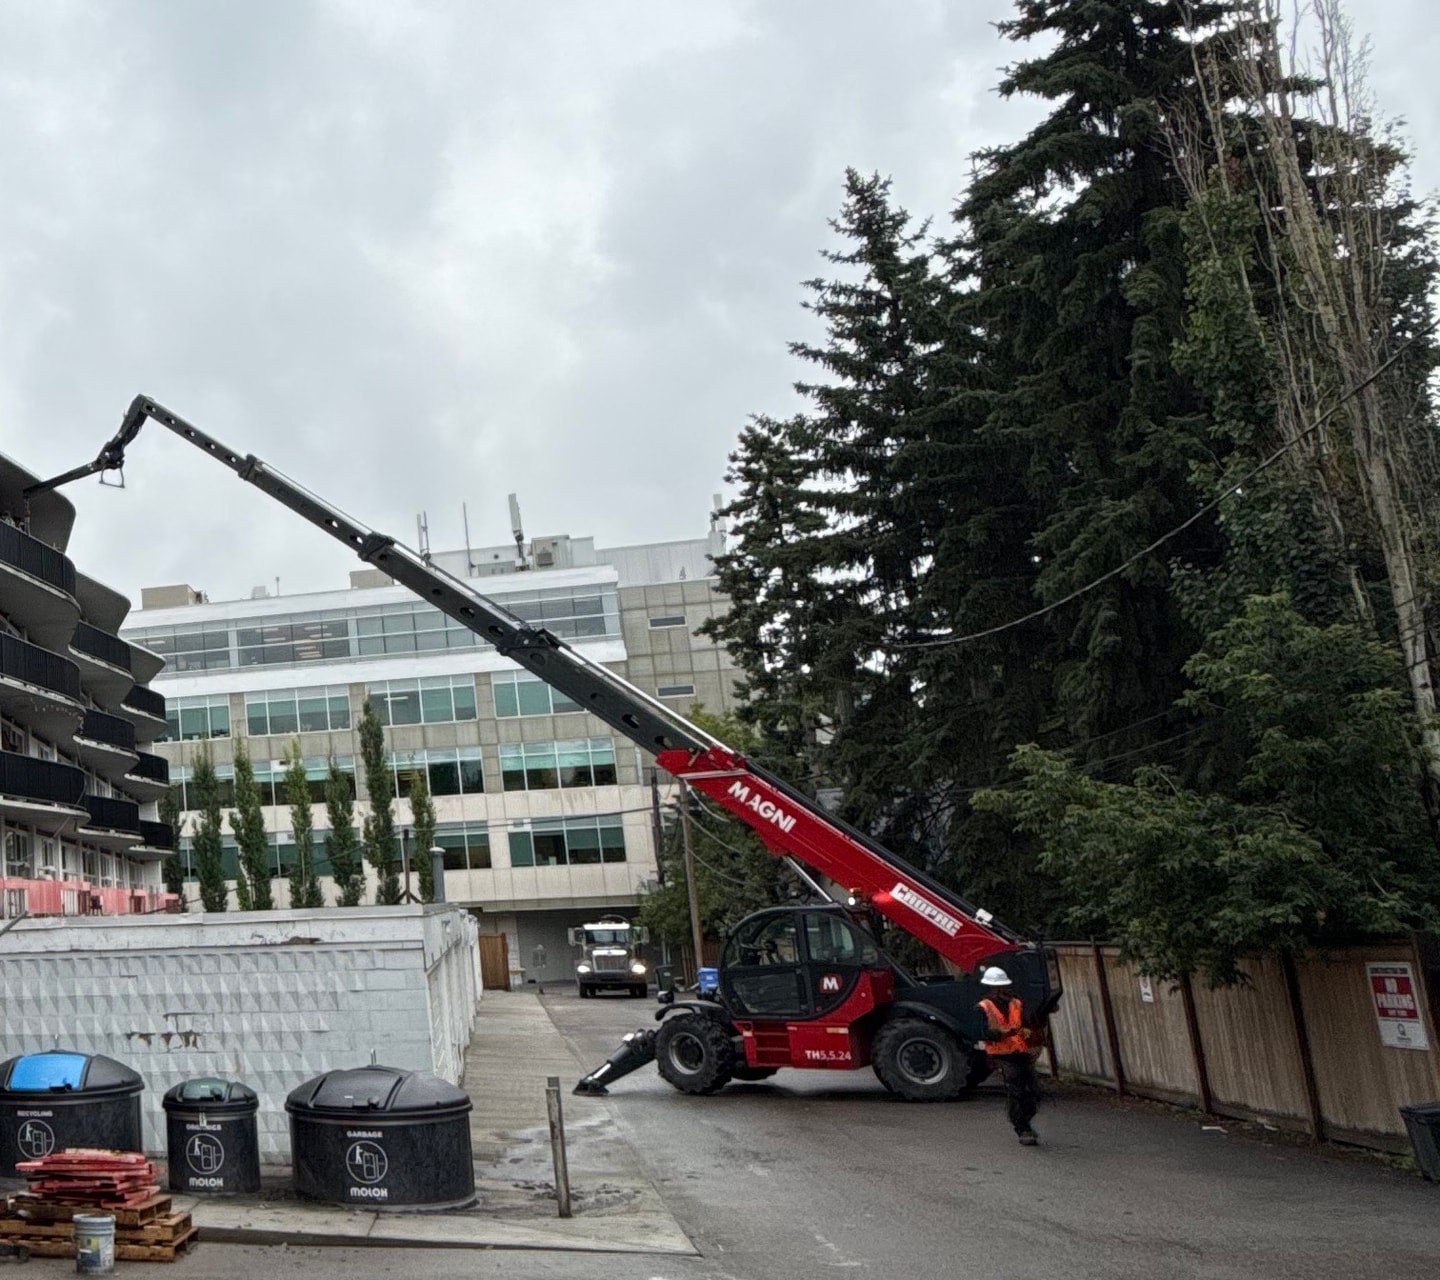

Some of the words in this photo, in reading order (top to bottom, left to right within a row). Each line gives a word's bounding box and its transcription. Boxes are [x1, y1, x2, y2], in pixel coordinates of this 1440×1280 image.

[727, 780, 798, 834] MAGNI
[823, 976, 839, 990] M
[346, 1130, 383, 1138] GARBAGE
[350, 1186, 388, 1198] MOLOK
